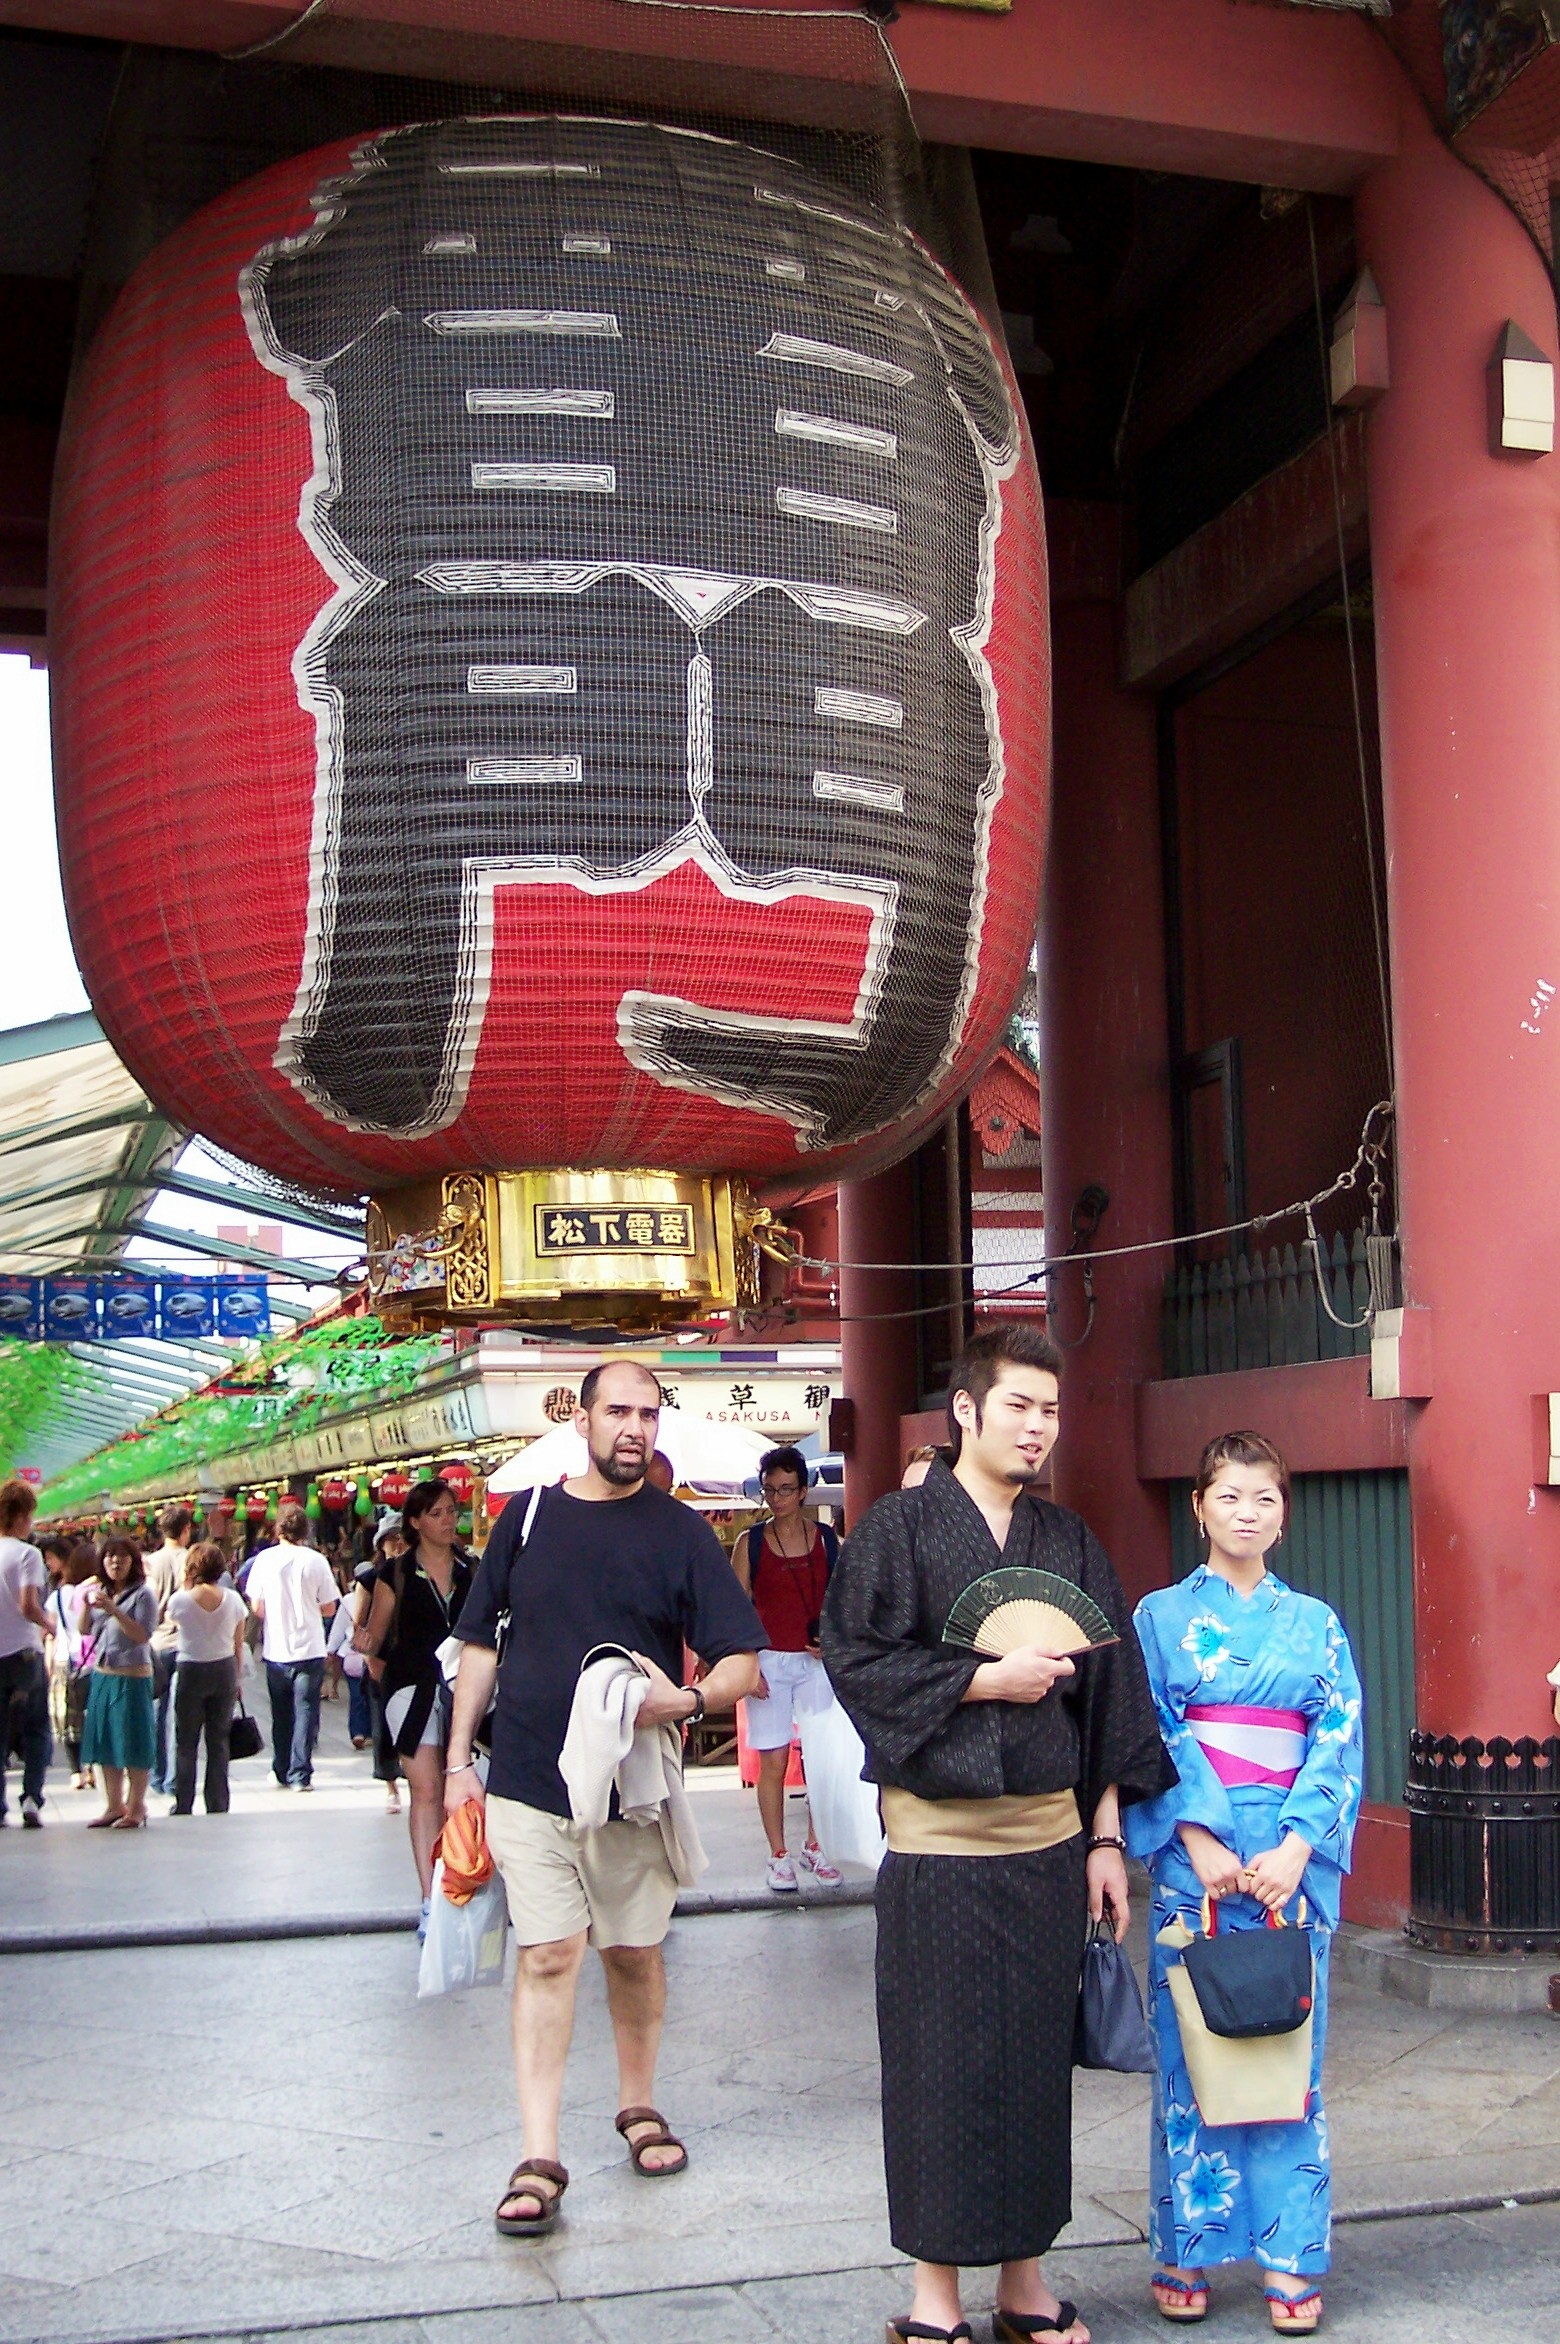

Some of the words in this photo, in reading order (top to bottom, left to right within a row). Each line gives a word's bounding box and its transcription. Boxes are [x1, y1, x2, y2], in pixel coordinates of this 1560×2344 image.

[239, 114, 1018, 1151] 雷門
[548, 1213, 686, 1246] 松下電器
[705, 1410, 792, 1422] ASAKUSA
